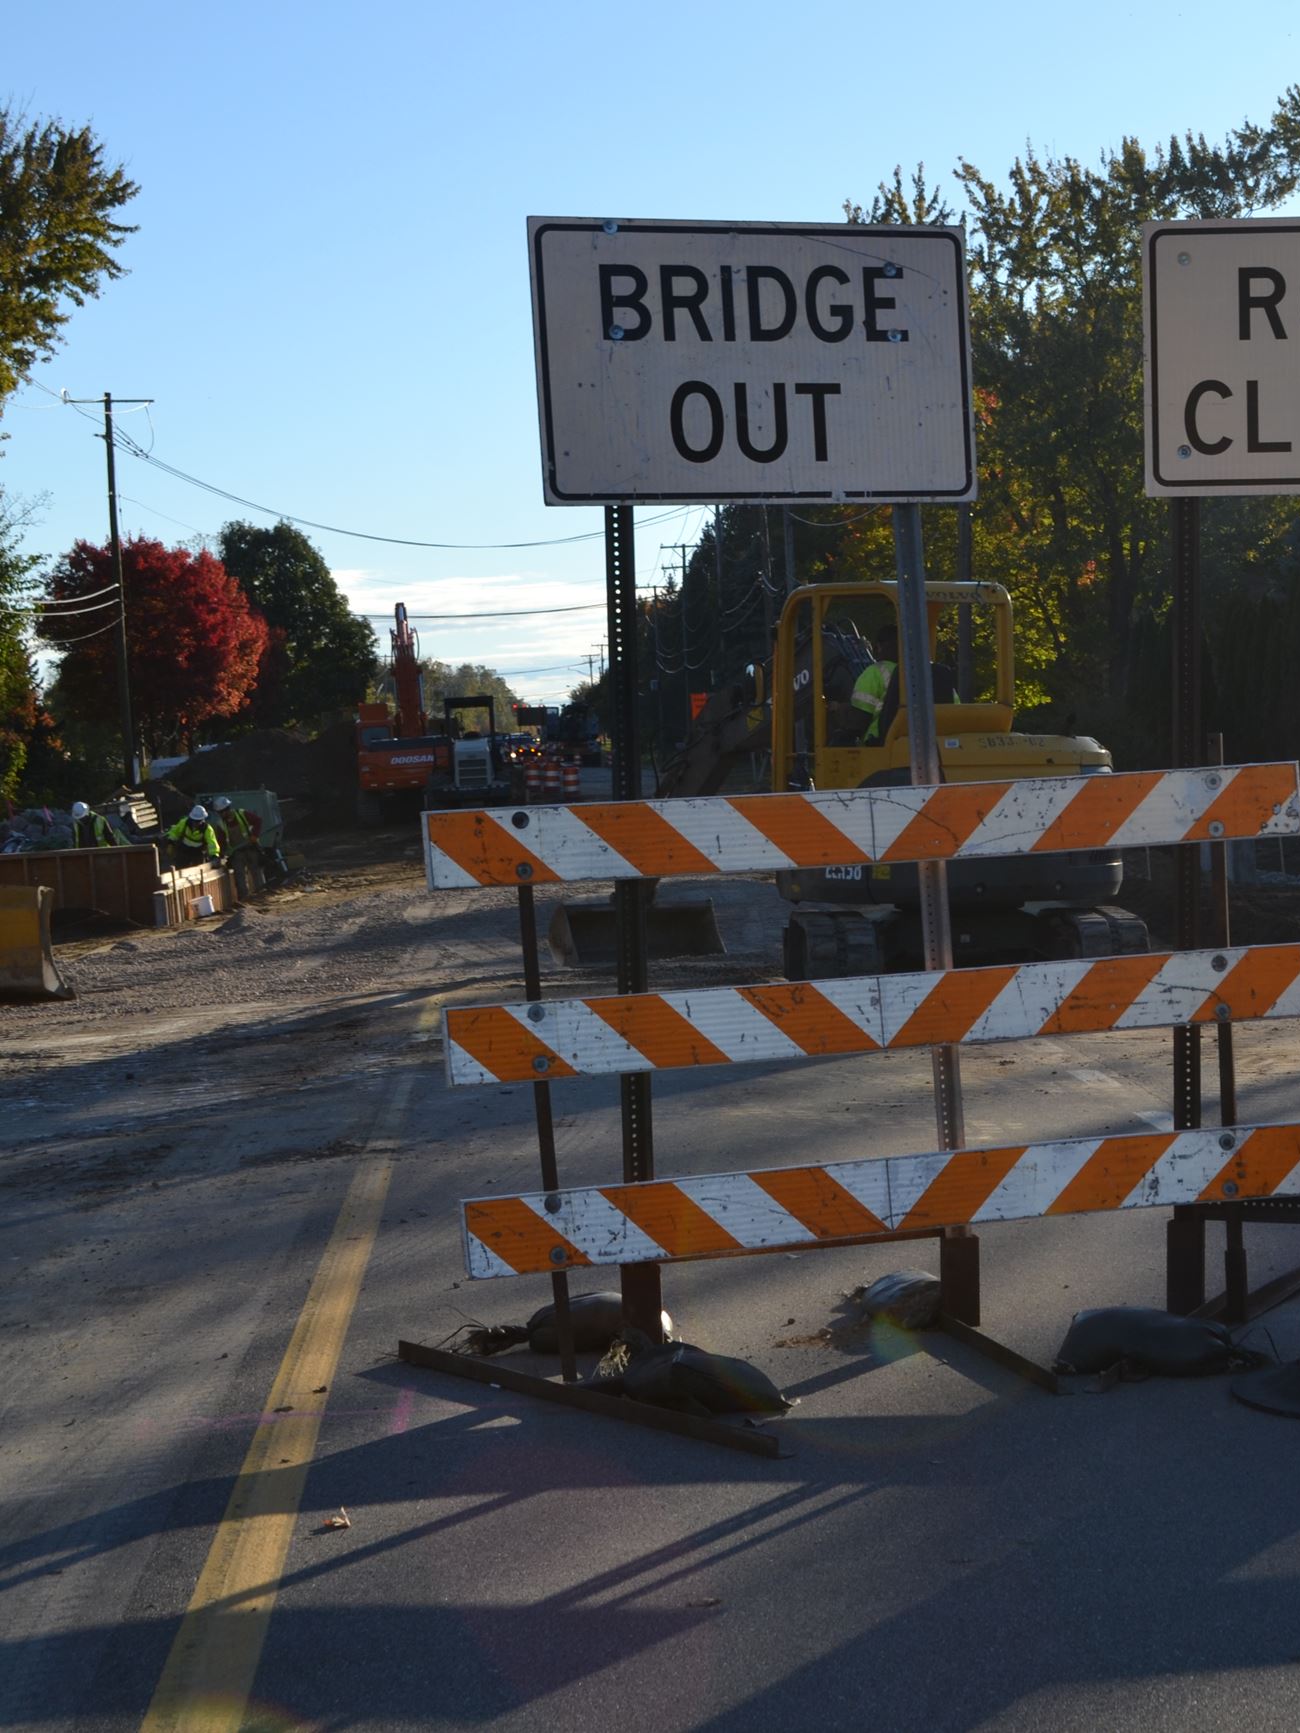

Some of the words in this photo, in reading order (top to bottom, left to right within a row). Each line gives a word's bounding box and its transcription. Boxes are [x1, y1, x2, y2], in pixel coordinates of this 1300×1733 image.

[598, 264, 908, 343] BRIDGE
[670, 380, 841, 463] OUT
[390, 754, 435, 765] DOOSAN
